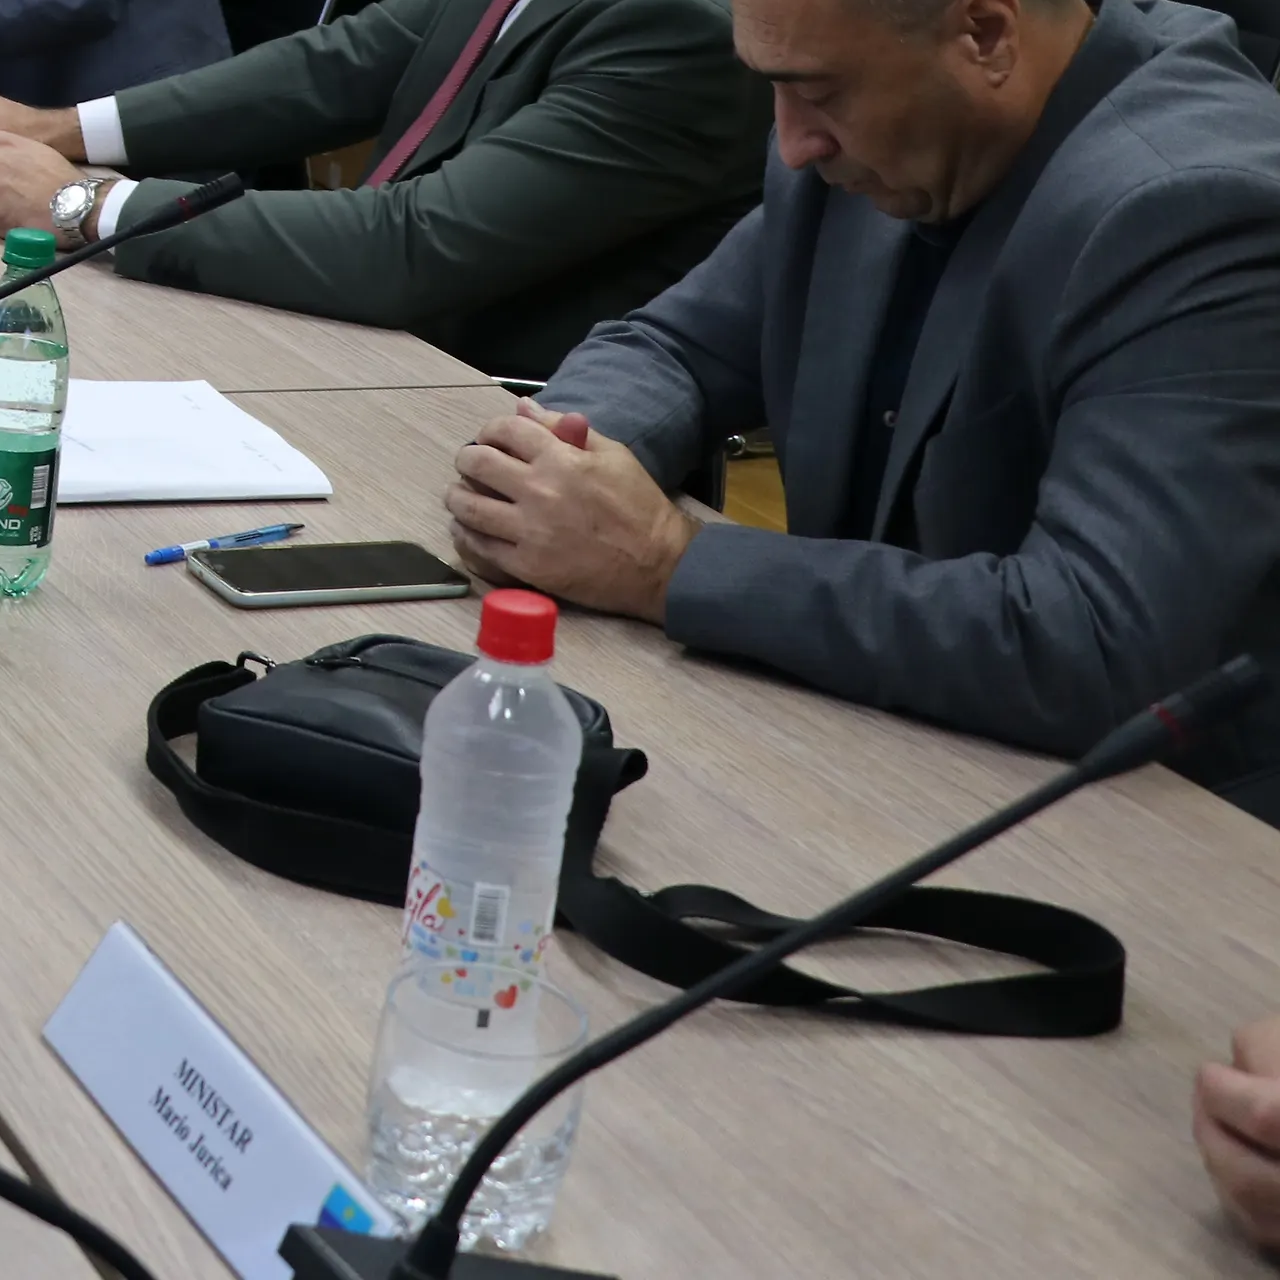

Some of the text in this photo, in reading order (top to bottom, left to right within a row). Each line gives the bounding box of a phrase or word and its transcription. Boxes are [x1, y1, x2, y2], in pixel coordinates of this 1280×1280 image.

[148, 1084, 233, 1192] Mario Jurica
[173, 1056, 254, 1154] MINISTAR
